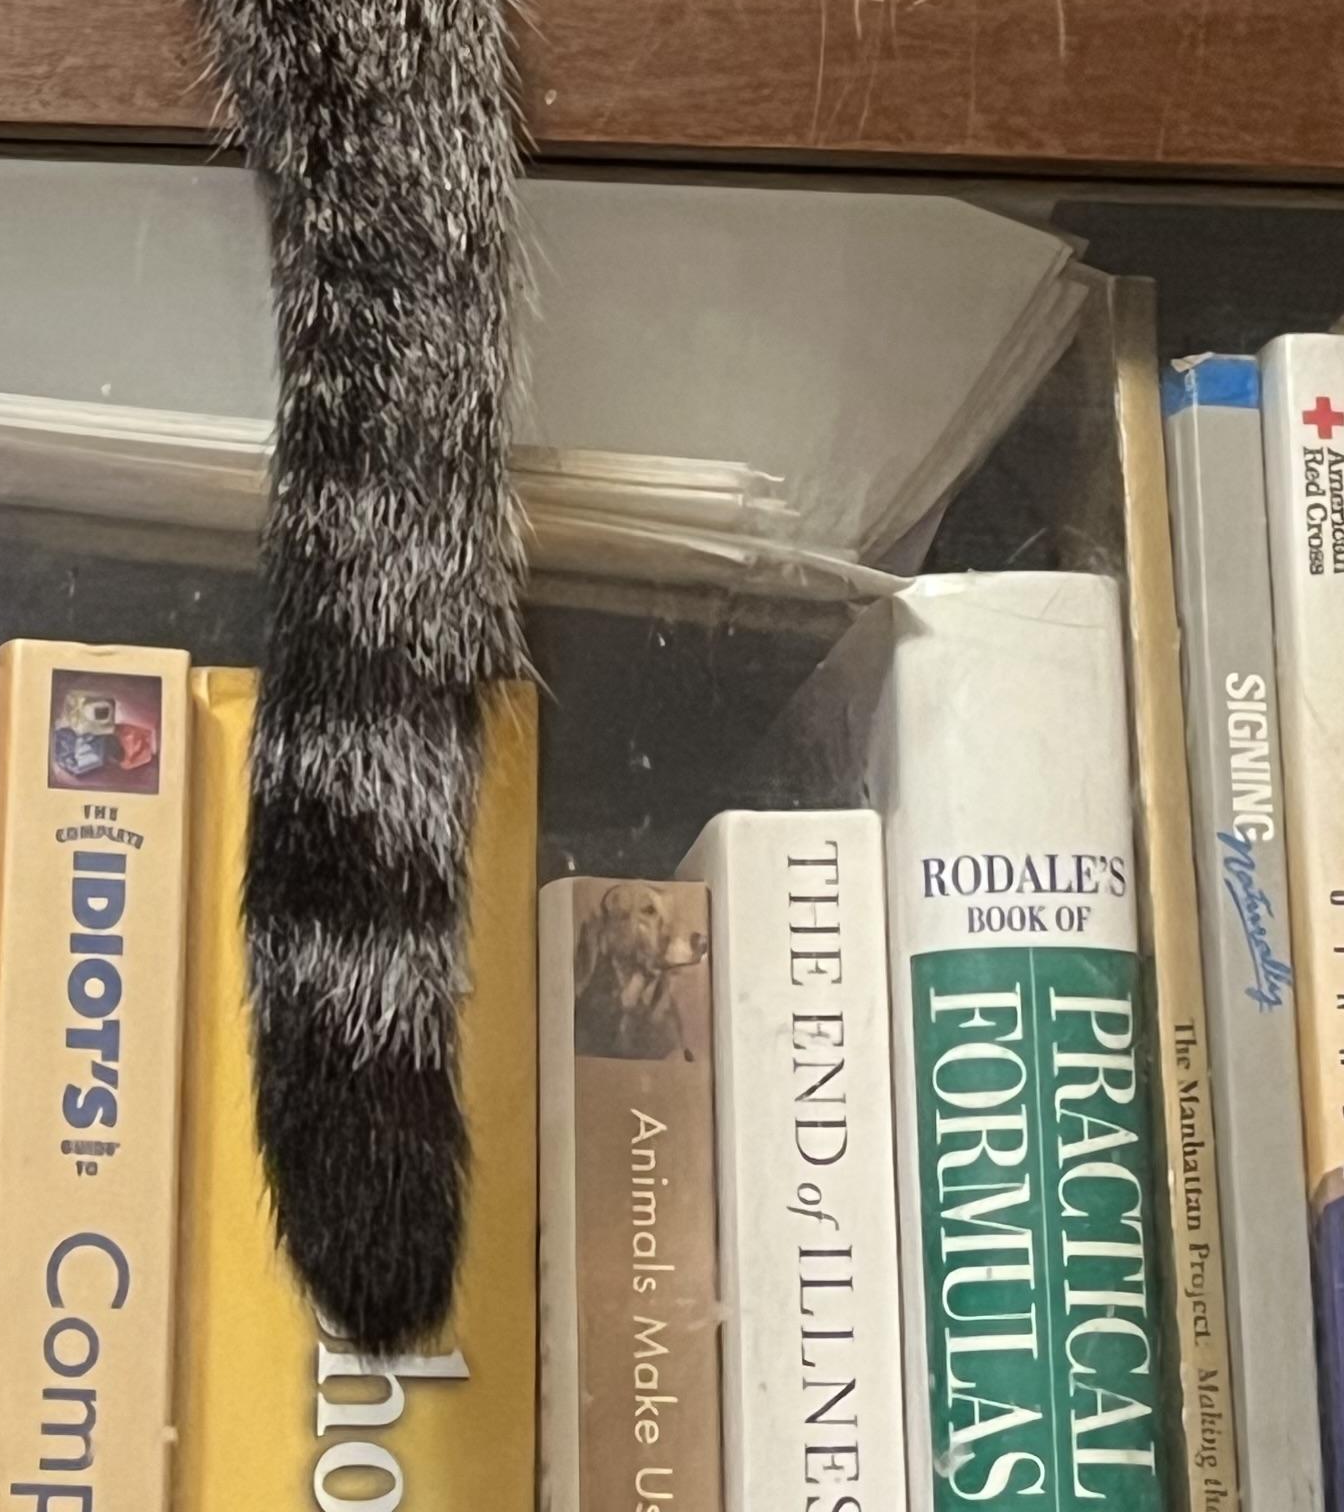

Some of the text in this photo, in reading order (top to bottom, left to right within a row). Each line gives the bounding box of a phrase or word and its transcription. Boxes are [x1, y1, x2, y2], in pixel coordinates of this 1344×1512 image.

[1302, 445, 1329, 576] Red Cross
[1224, 672, 1275, 845] SIGNING
[786, 840, 843, 987] THE
[921, 853, 1127, 898] RODALE'S
[967, 905, 1092, 934] BOOK OF
[1216, 830, 1294, 1014] Naturally
[61, 850, 128, 1129] IDIOT'S
[1174, 1018, 1198, 1071] The
[791, 1010, 849, 1167] END
[1177, 1080, 1206, 1232] Manhattan
[630, 1107, 676, 1294] Animals
[786, 1182, 840, 1232] of
[929, 981, 1046, 1502] FORMULAS
[1049, 985, 1159, 1501] PRACTICAL
[632, 1314, 679, 1445] Make
[1194, 1367, 1223, 1469] Making
